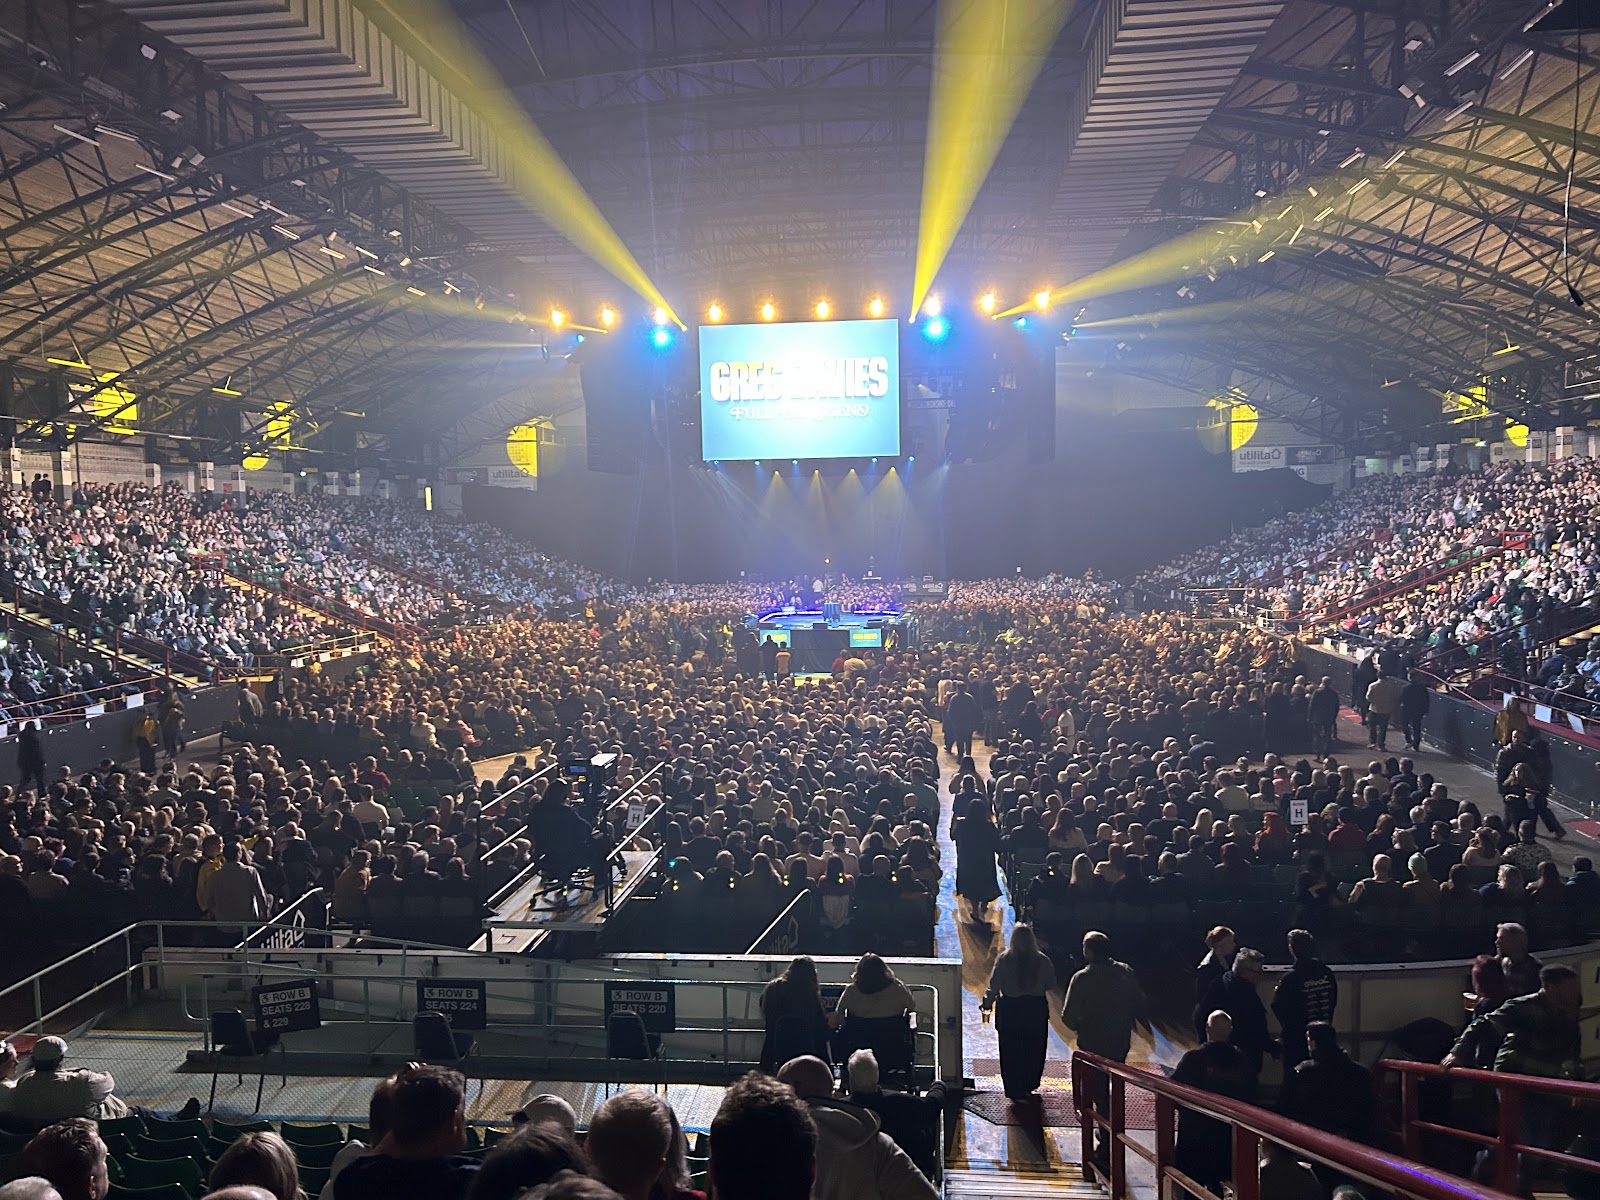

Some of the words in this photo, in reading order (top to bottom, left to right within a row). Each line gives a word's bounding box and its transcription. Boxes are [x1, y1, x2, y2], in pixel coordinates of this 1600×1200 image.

[1239, 450, 1270, 460] utilita
[492, 469, 520, 479] utilita
[632, 813, 640, 823] H
[1295, 808, 1302, 818] H
[272, 990, 296, 1001] ROW
[298, 989, 306, 998] B
[438, 989, 463, 998] ROW
[466, 989, 473, 998] B
[626, 991, 651, 1001] ROW
[655, 992, 662, 1001] B
[262, 1003, 292, 1016] SEATS
[294, 1001, 311, 1012] 228
[425, 1000, 458, 1010] SEATS
[460, 1001, 477, 1011] 224
[613, 1003, 646, 1013] SEATS
[648, 1004, 667, 1014] 220
[263, 1019, 270, 1029] &
[272, 1017, 289, 1028] 229
